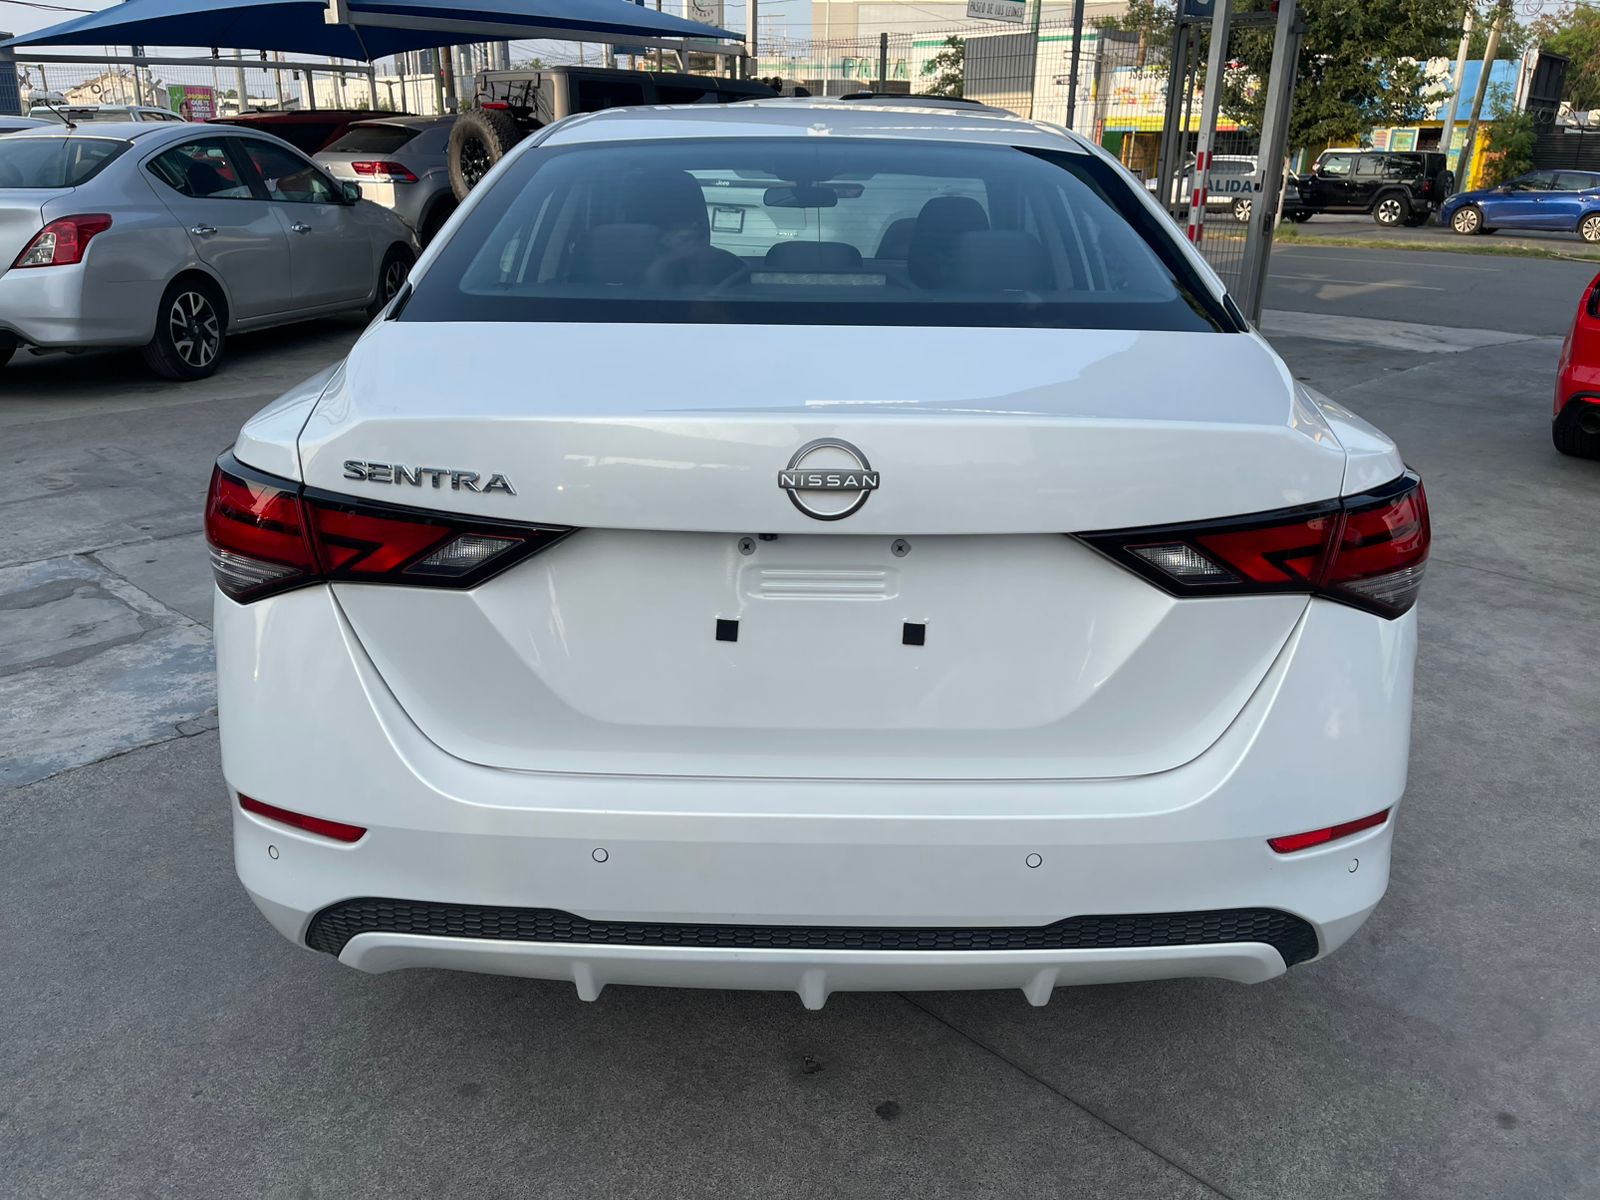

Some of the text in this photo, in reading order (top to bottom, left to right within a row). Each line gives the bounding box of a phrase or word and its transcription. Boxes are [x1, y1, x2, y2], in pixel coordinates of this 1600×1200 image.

[969, 1, 986, 14] PASEO
[1207, 179, 1253, 193] ALIDA
[343, 459, 518, 496] SENTRA
[781, 474, 877, 487] NISSAN
